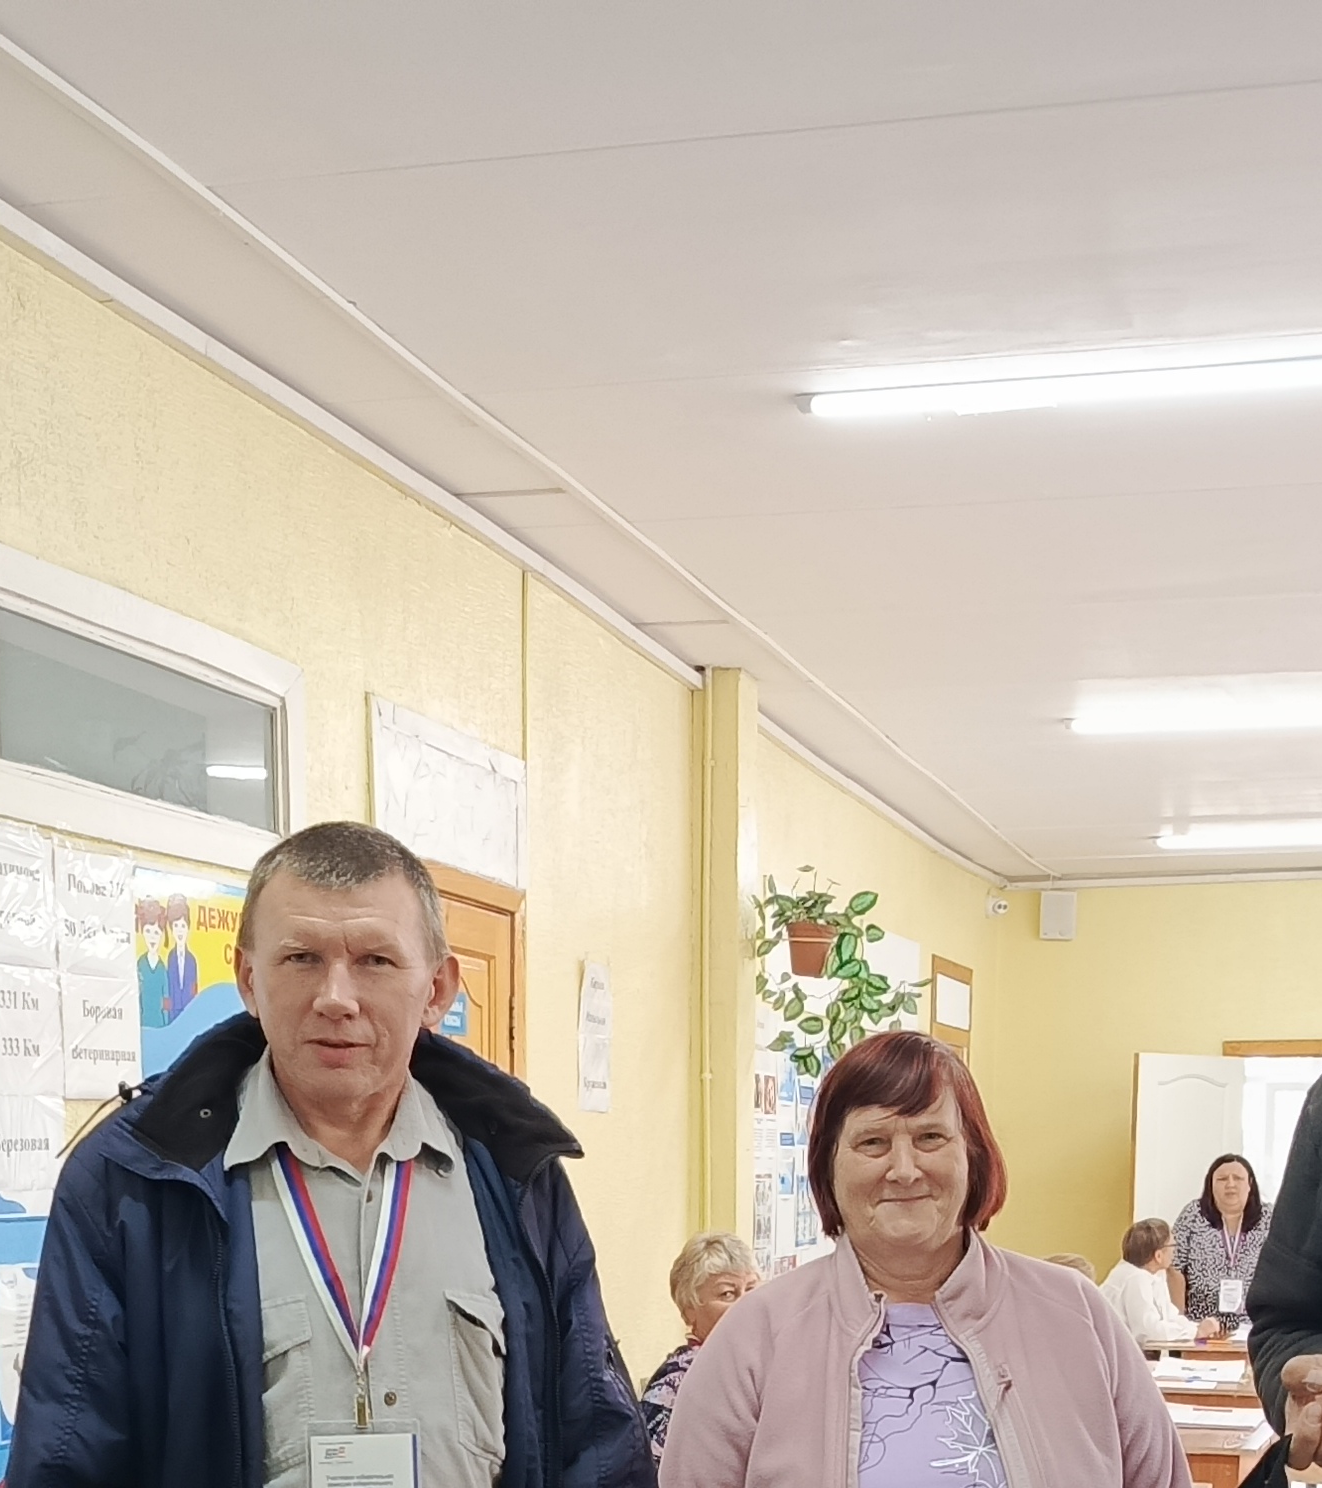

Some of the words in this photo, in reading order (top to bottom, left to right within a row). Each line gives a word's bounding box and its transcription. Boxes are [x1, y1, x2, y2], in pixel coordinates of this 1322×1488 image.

[0, 990, 18, 1010] 331
[22, 991, 39, 1011] Км
[2, 1037, 20, 1056] 333
[23, 1038, 40, 1057] Км
[72, 1045, 137, 1065] Ветеринарная
